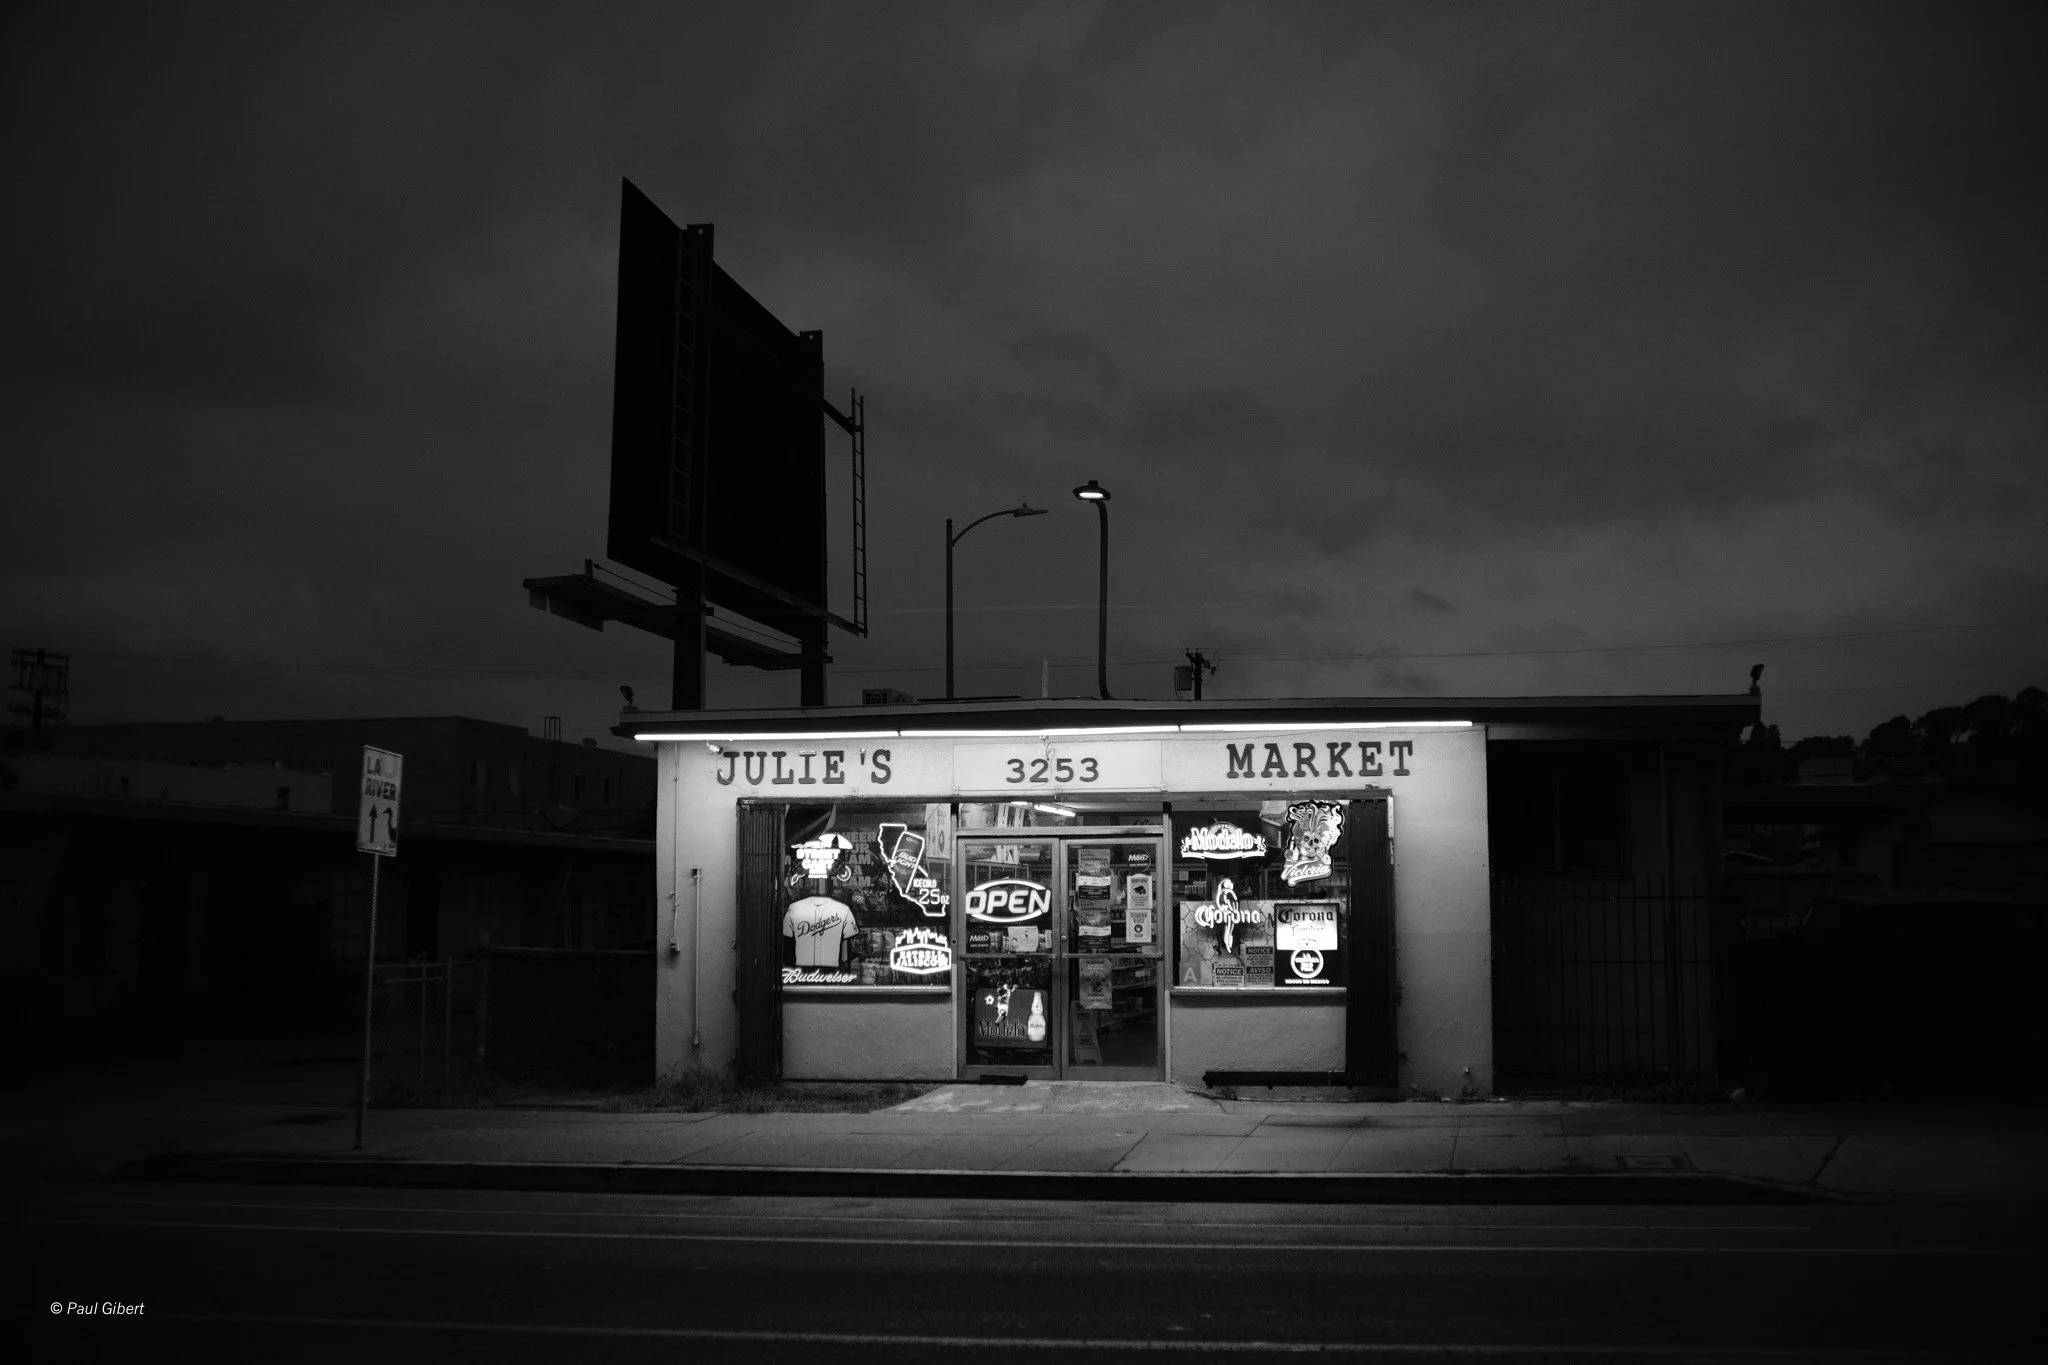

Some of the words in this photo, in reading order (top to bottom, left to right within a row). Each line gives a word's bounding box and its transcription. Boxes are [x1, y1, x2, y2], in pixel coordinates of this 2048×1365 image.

[367, 755, 381, 776] LA
[717, 748, 892, 786] JULIE'S
[1006, 757, 1099, 784] 3253
[1226, 740, 1414, 779] MARKET
[365, 777, 396, 802] RIVER
[1191, 826, 1254, 851] Modelo
[965, 889, 1051, 914] OPEN
[797, 913, 841, 938] Dodgers
[1194, 904, 1261, 929] Corona
[1277, 908, 1335, 926] Corona
[782, 967, 858, 984] Budweiser
[1183, 966, 1198, 982] A
[978, 1019, 1028, 1039] Modelo
